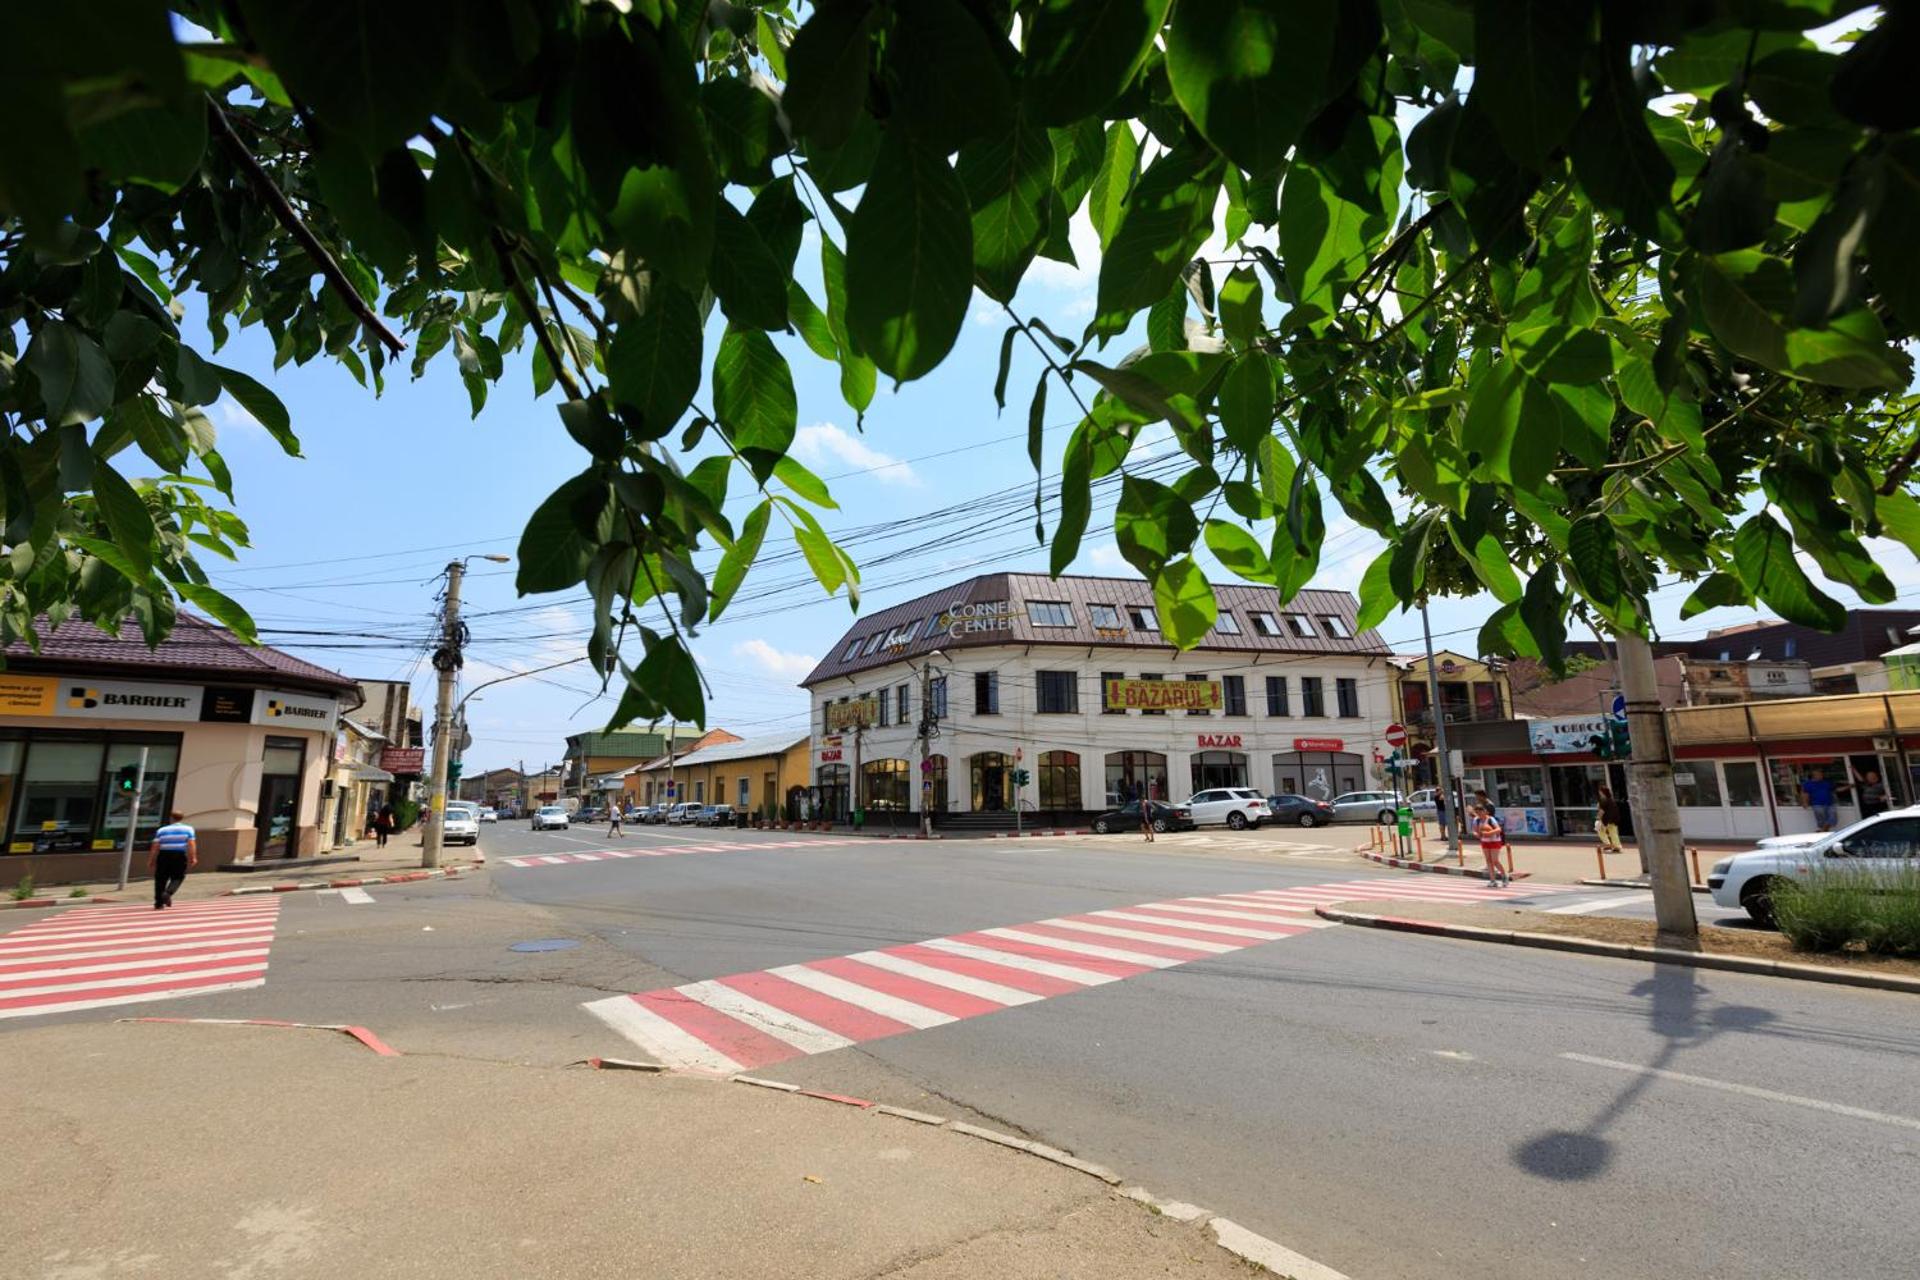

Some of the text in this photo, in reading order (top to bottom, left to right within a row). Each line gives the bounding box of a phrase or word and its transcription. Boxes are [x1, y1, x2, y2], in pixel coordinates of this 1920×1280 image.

[103, 693, 189, 708] BARRIER
[1125, 688, 1206, 707] BAZARUL
[284, 706, 327, 719] BARRIER
[1197, 735, 1242, 748] BAZAR
[821, 749, 842, 762] BAZAR
